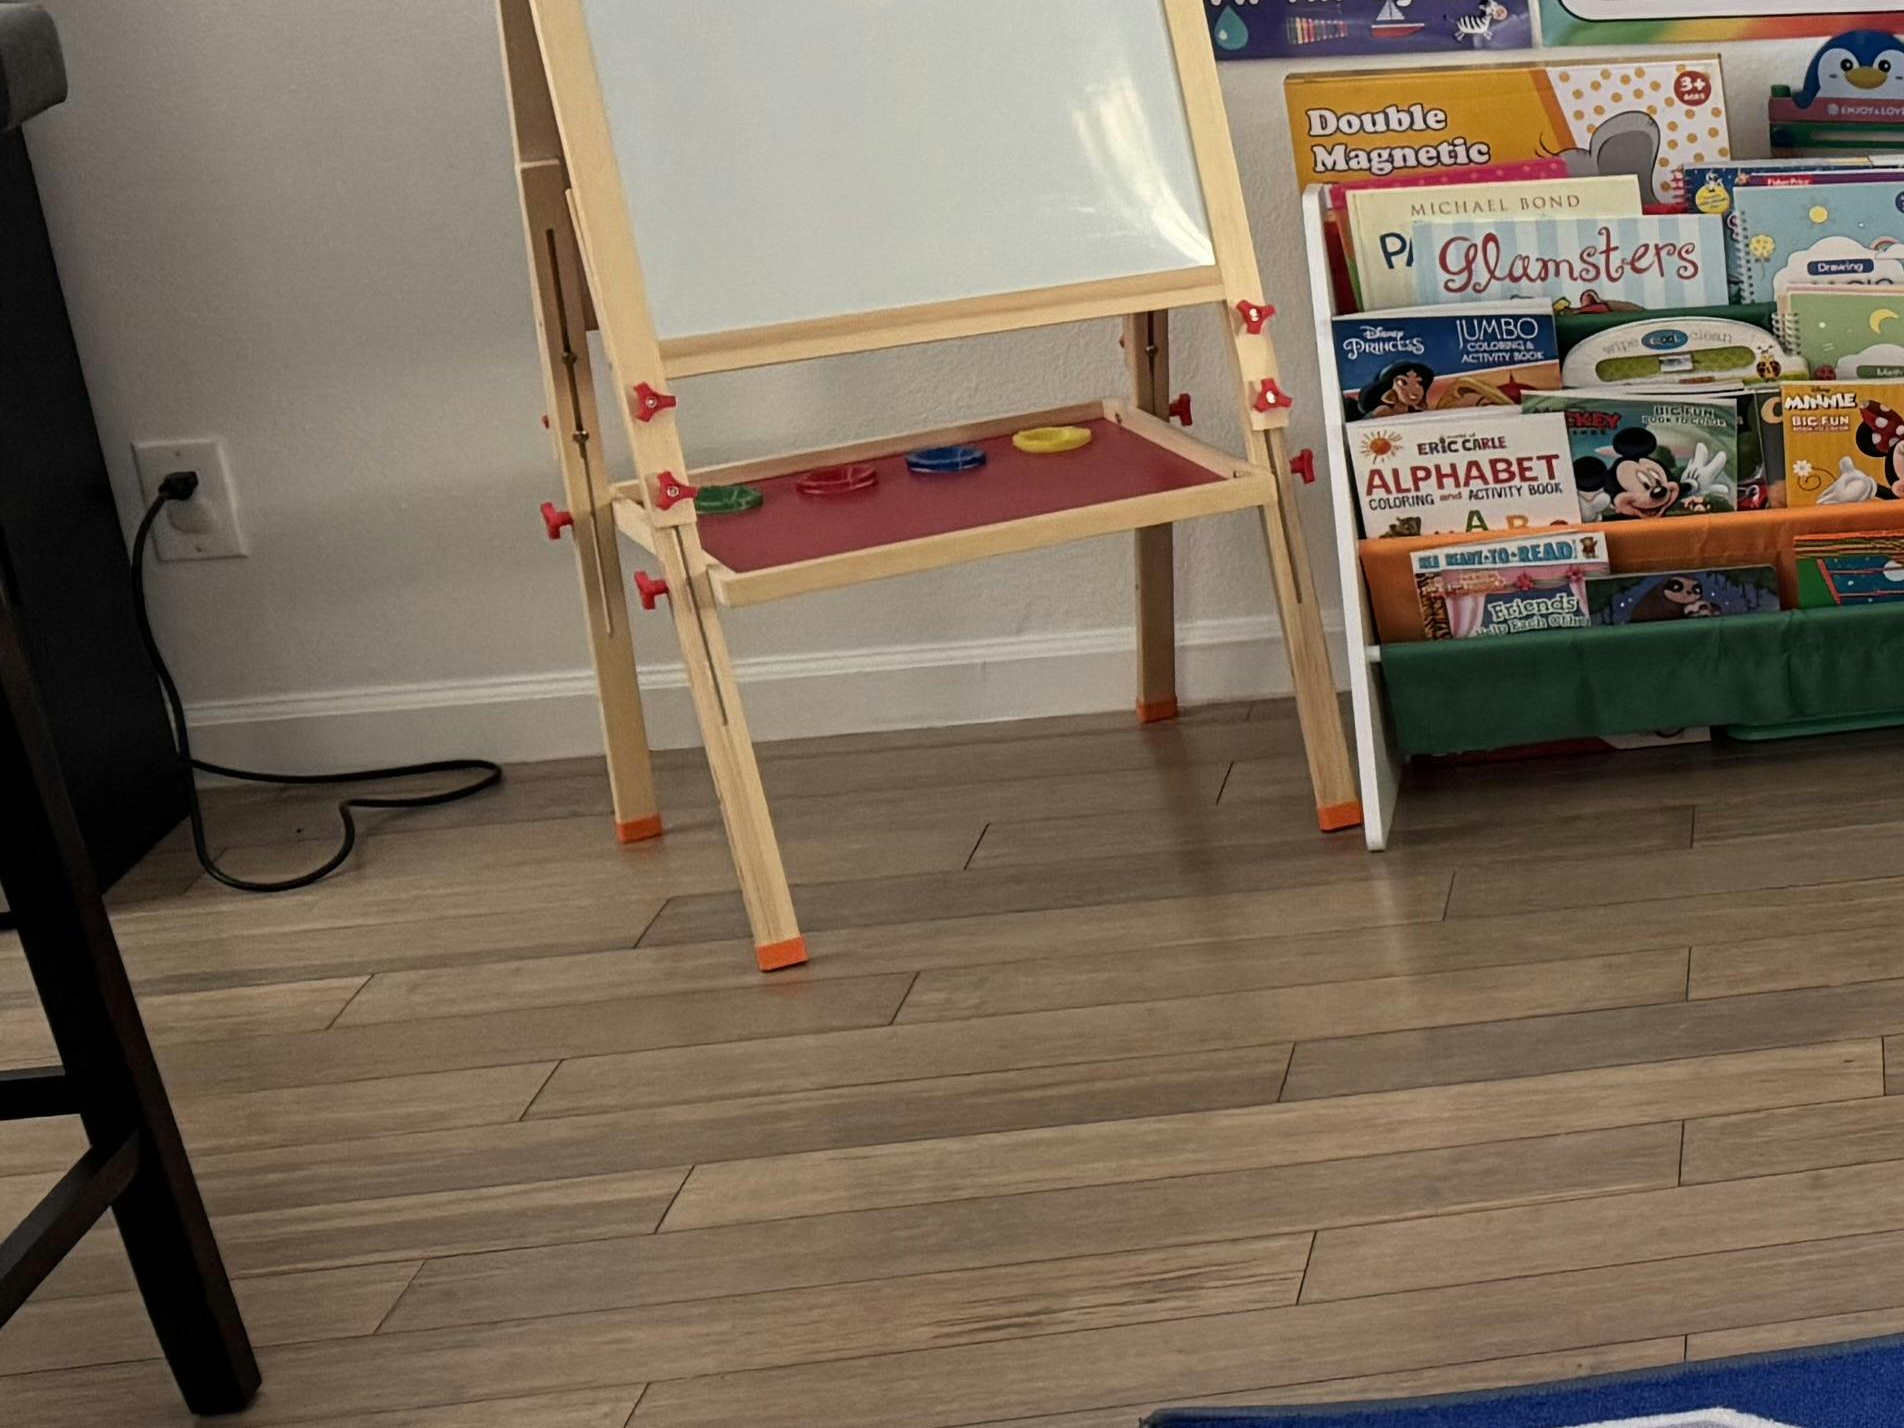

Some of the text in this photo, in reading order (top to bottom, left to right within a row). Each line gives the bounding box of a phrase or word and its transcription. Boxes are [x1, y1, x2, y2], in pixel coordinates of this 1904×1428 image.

[1677, 76, 1705, 91] 3+
[1306, 103, 1447, 137] Double
[1311, 138, 1490, 174] Magnetic
[1411, 194, 1581, 217] MICHAEL BOND
[1439, 227, 1699, 294] Glamsters
[1818, 262, 1863, 272] Drawing
[1456, 318, 1537, 349] JUMBO
[1343, 338, 1424, 359] PRINCESS
[1461, 352, 1544, 363] ACTIVITY BOOK
[1785, 393, 1856, 410] MINNIE
[1463, 436, 1507, 451] CARLE
[1366, 454, 1559, 496] ALPHABET
[1369, 483, 1562, 510] COLORING and ACTIVITY BOOK
[1488, 594, 1578, 621] Friends
